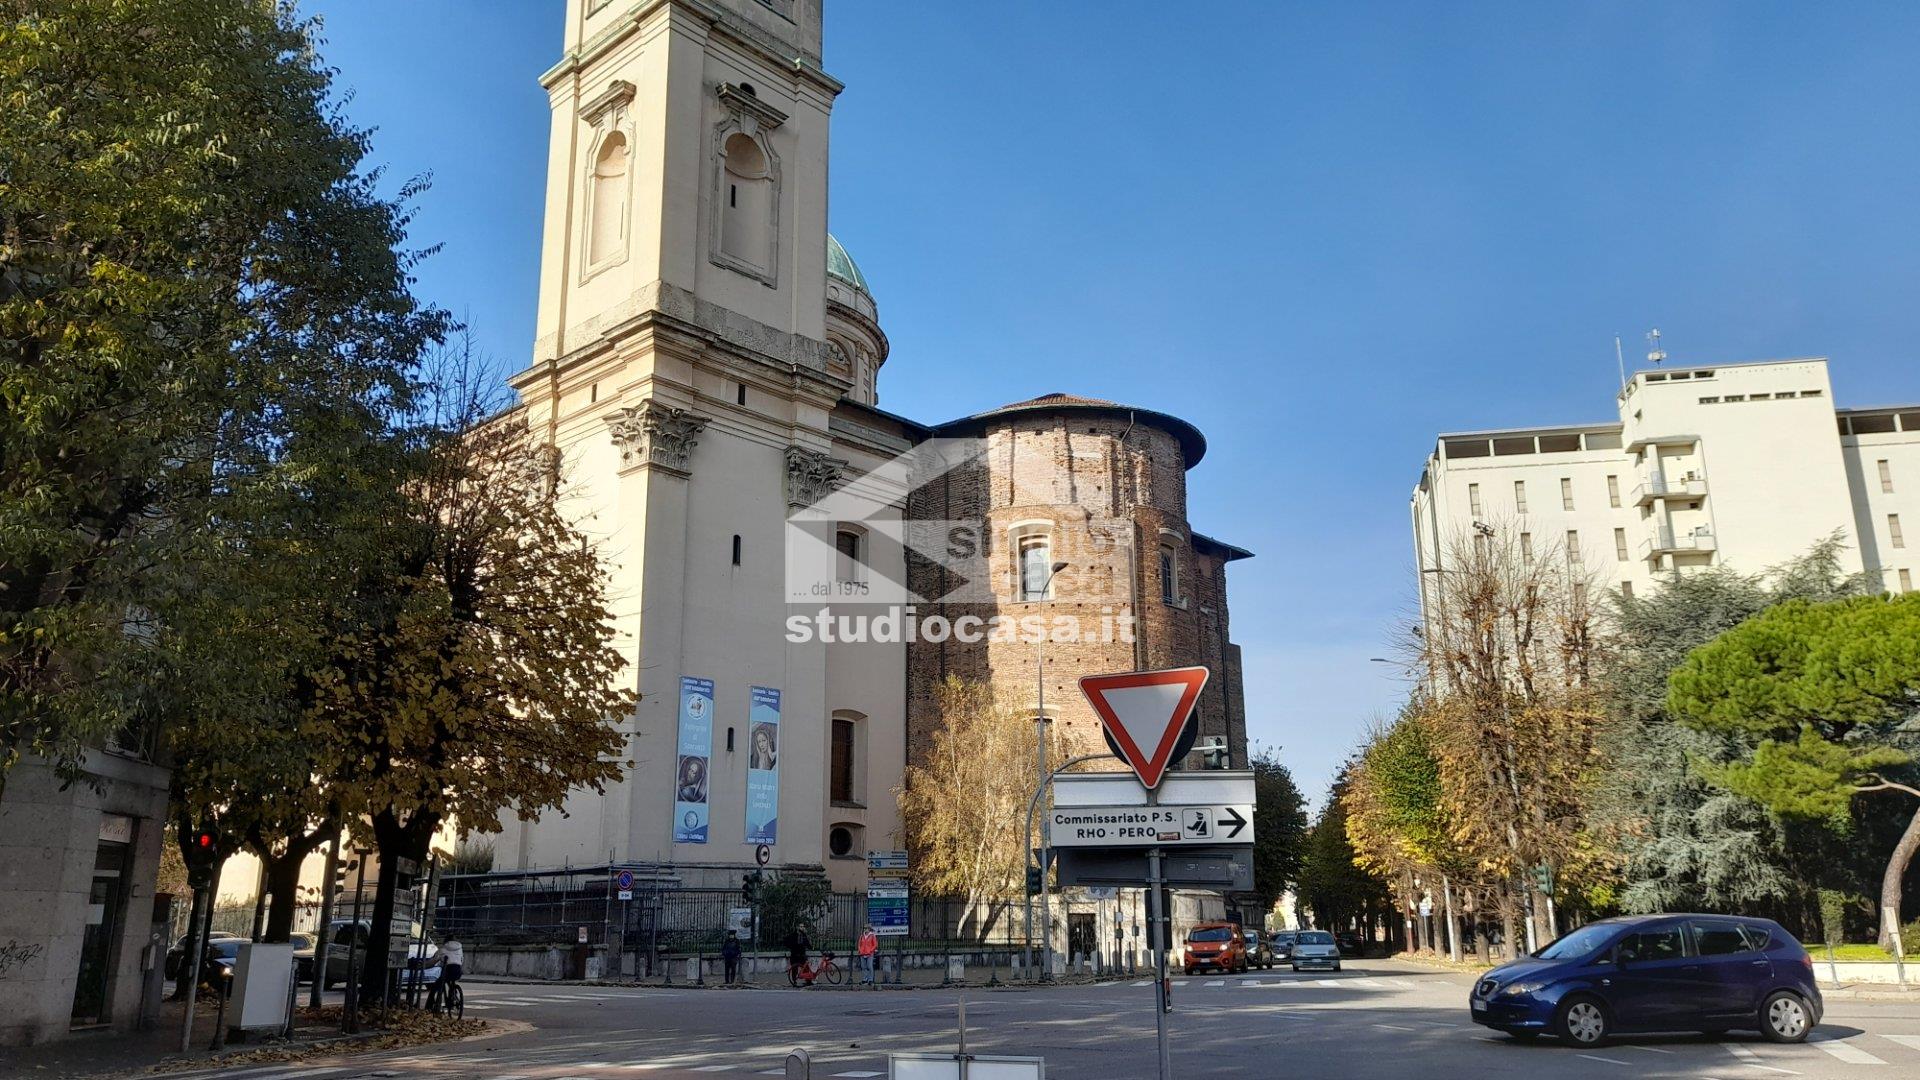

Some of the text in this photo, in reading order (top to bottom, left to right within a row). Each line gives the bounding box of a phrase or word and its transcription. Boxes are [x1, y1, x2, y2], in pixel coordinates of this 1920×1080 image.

[1055, 812, 1177, 825] Commissariato P.S.
[1077, 828, 1106, 839] RHO
[1119, 827, 1156, 838] PERO
